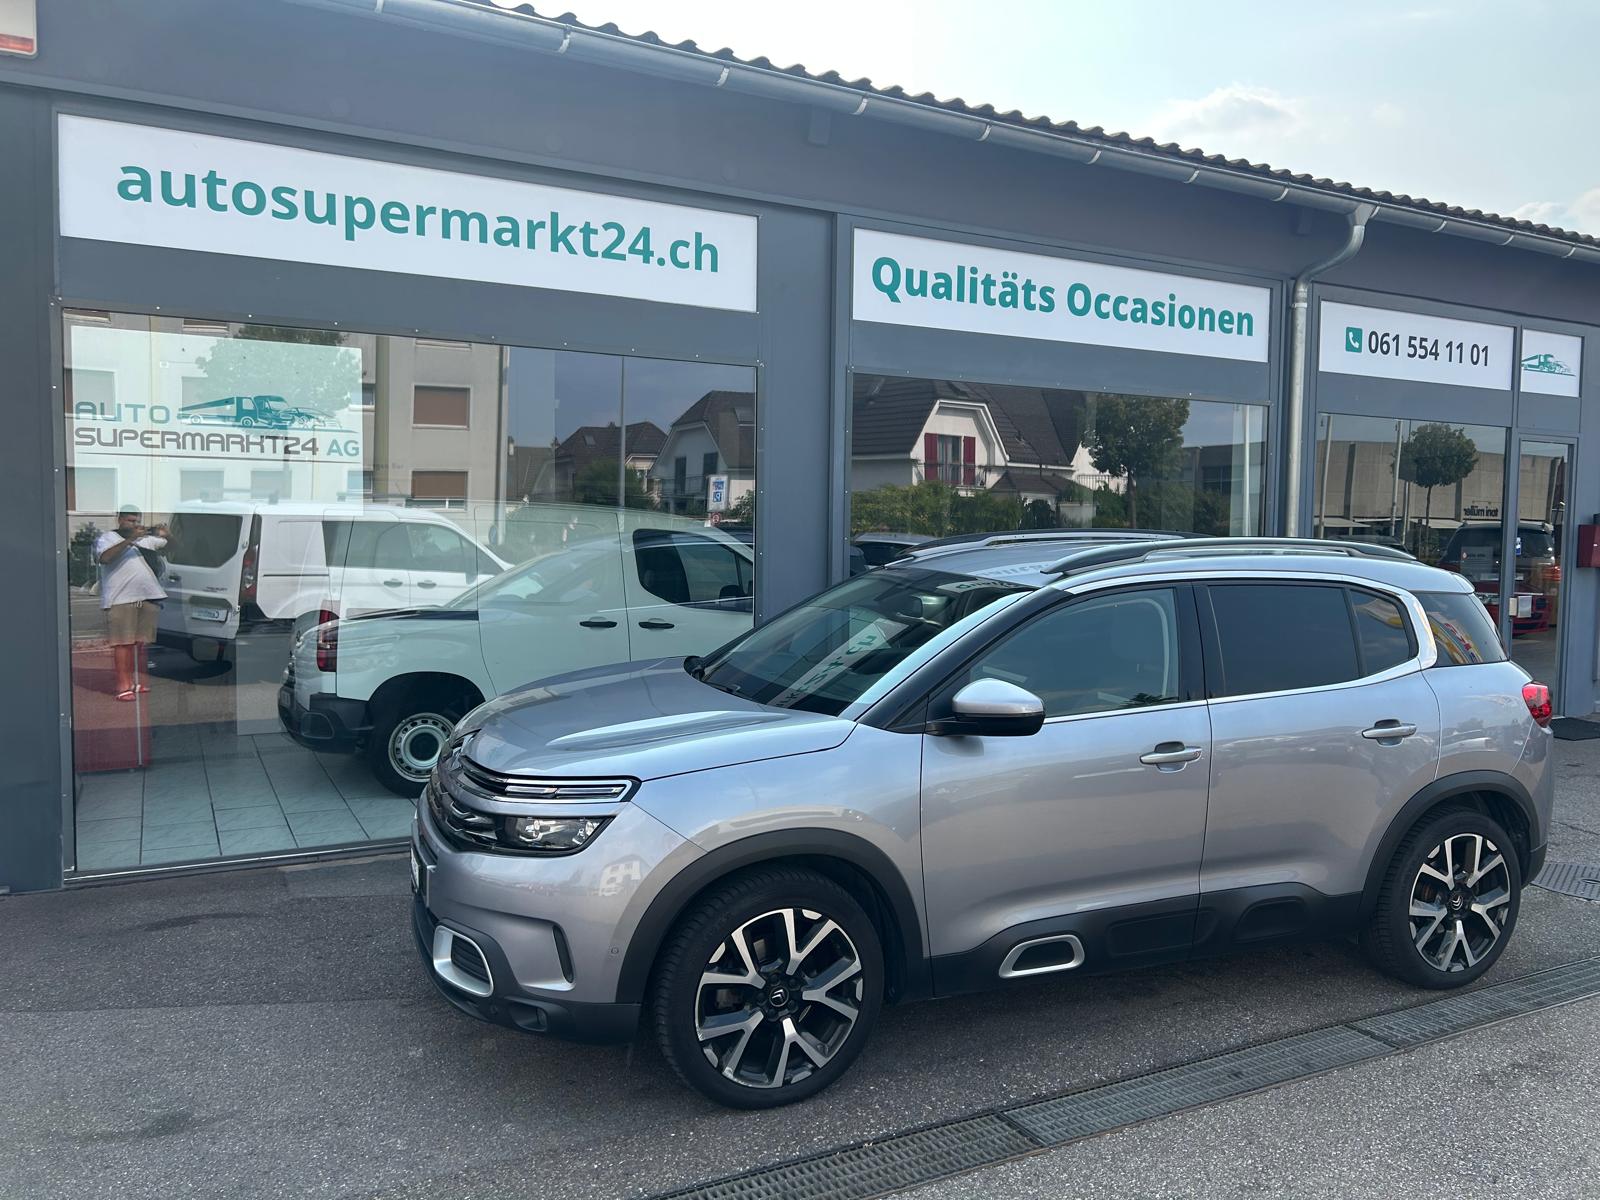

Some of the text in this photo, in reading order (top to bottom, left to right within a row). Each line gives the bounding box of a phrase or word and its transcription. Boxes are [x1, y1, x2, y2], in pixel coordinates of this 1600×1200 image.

[116, 164, 720, 274] autosupermarkt24.ch
[871, 256, 1255, 337] Qualitäts Occasionen
[1367, 330, 1489, 367] 061 554 11 01
[74, 401, 171, 424] AUTO
[74, 427, 360, 457] SUPERMARKT24 AG
